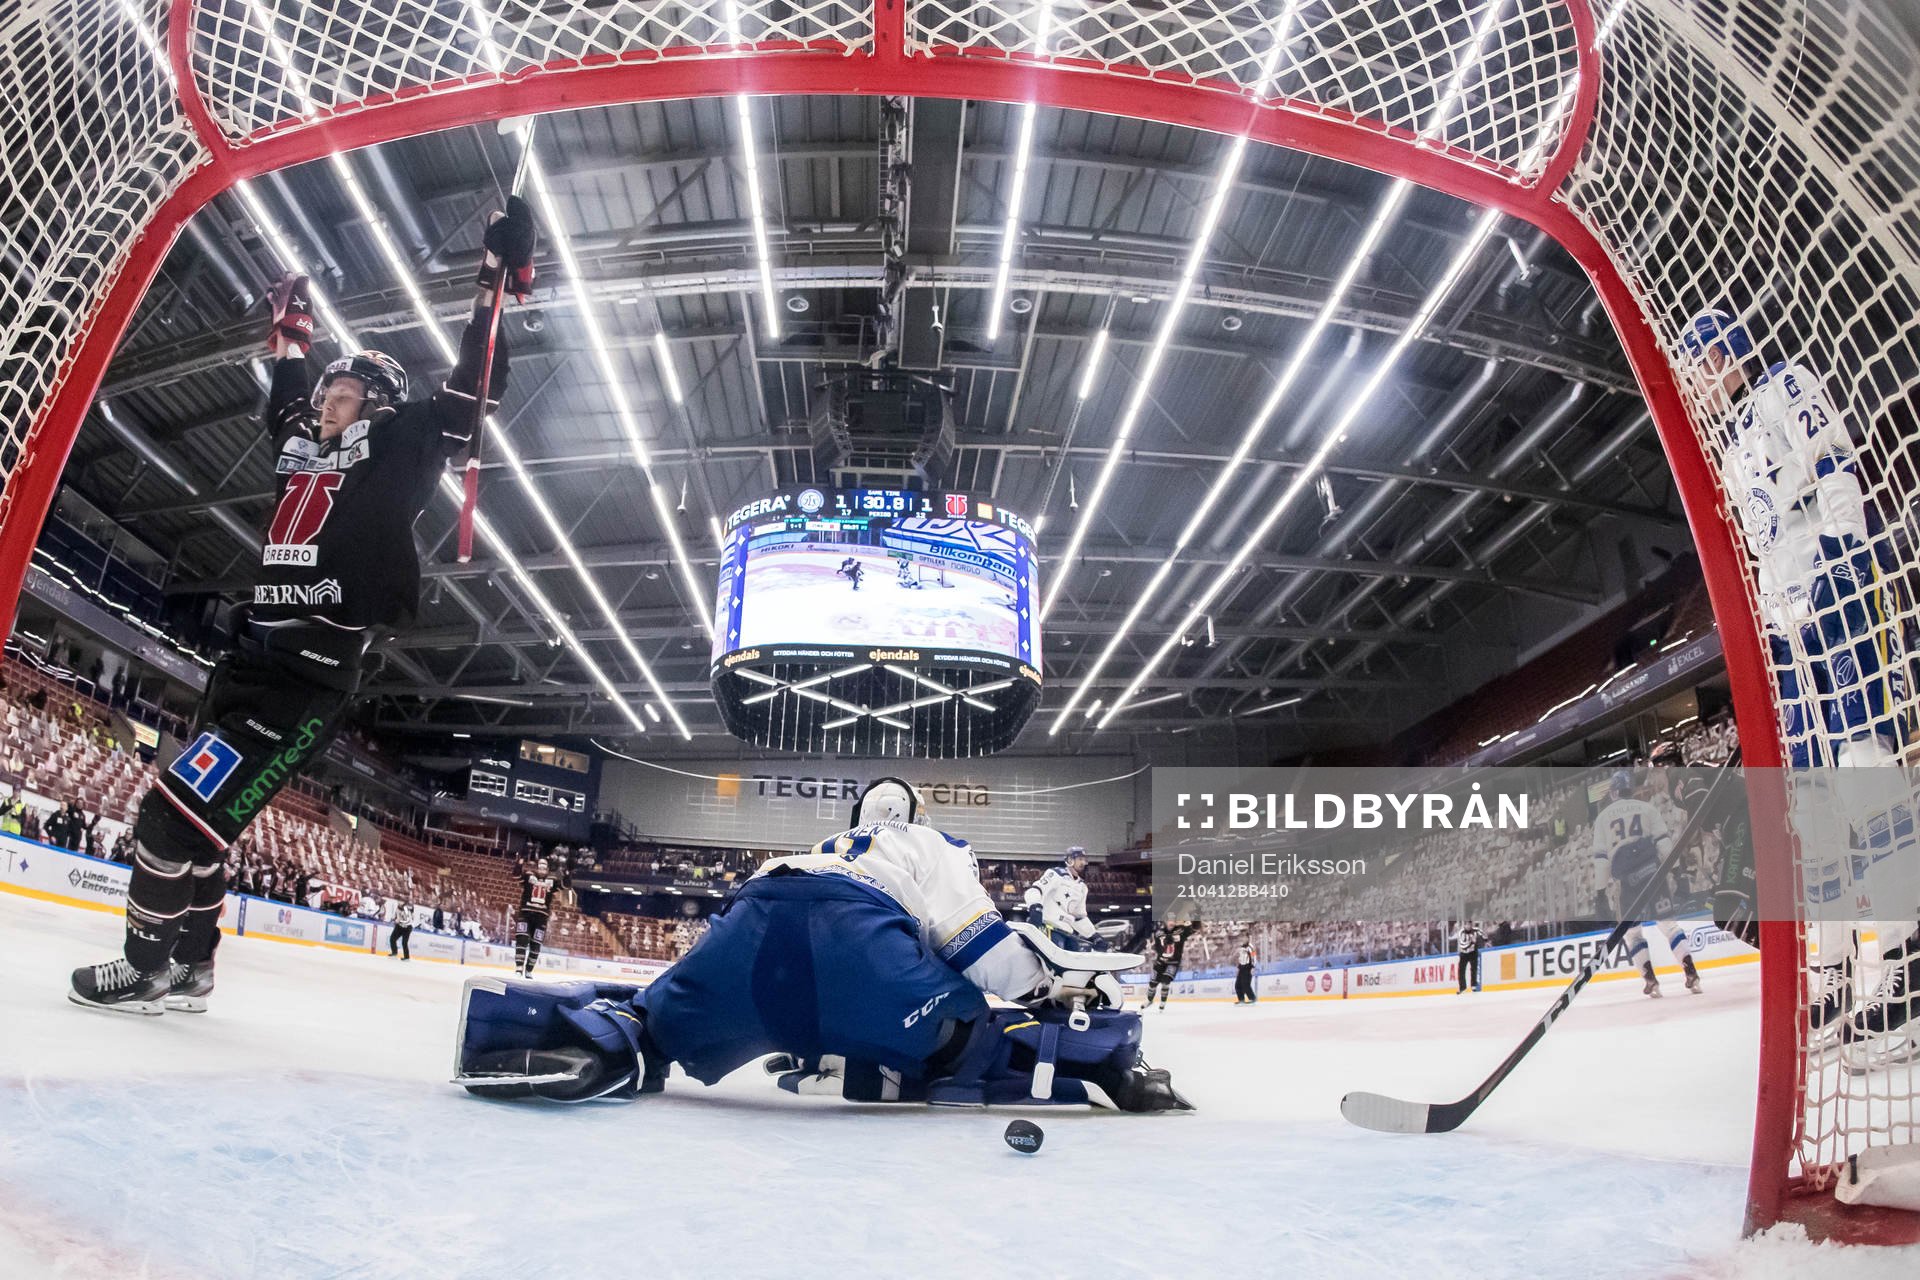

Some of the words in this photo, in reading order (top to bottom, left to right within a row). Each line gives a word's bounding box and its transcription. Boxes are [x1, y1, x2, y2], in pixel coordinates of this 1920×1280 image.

[1798, 404, 1829, 440] 23
[835, 495, 847, 508] 1
[863, 496, 904, 510] 30.8
[921, 498, 933, 512] 1
[724, 649, 760, 667] ejendals
[869, 648, 919, 662] ejendals
[753, 774, 862, 800] TEGER
[917, 782, 991, 806] rena
[1610, 813, 1643, 847] 34
[83, 870, 109, 883] Linde
